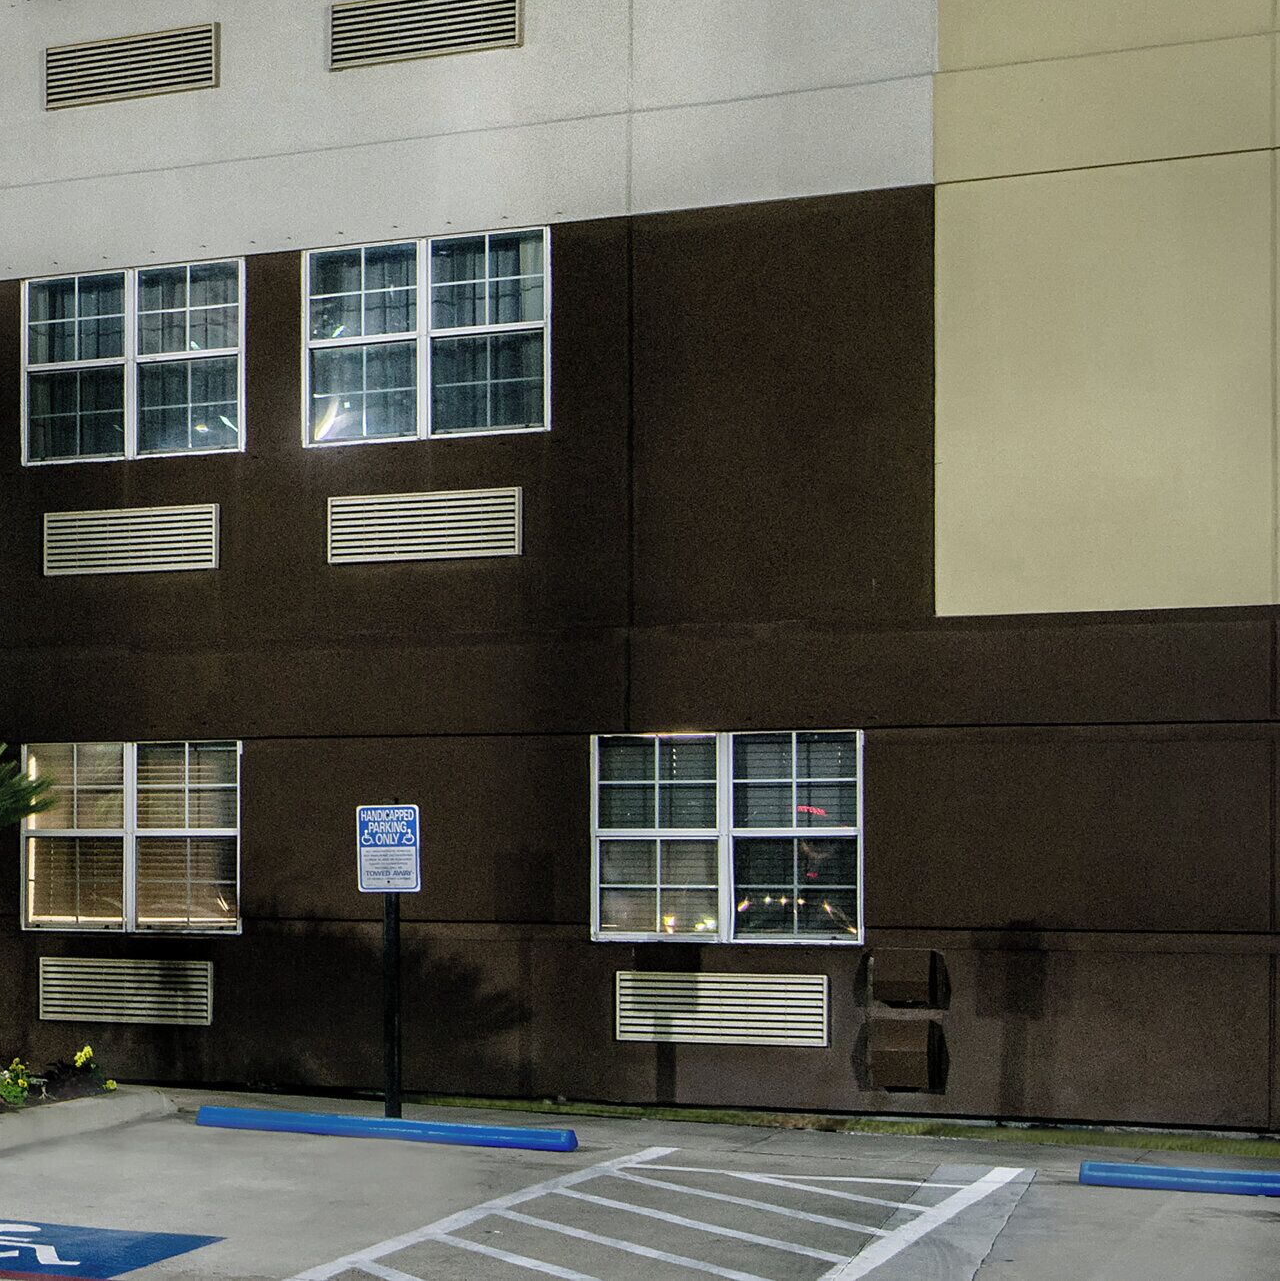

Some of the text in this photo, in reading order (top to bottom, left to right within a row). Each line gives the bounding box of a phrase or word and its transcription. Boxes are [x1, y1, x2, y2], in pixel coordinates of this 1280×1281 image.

[360, 809, 415, 821] HANDICAPPED
[368, 821, 407, 833] PARKING
[375, 833, 400, 845] ONLY
